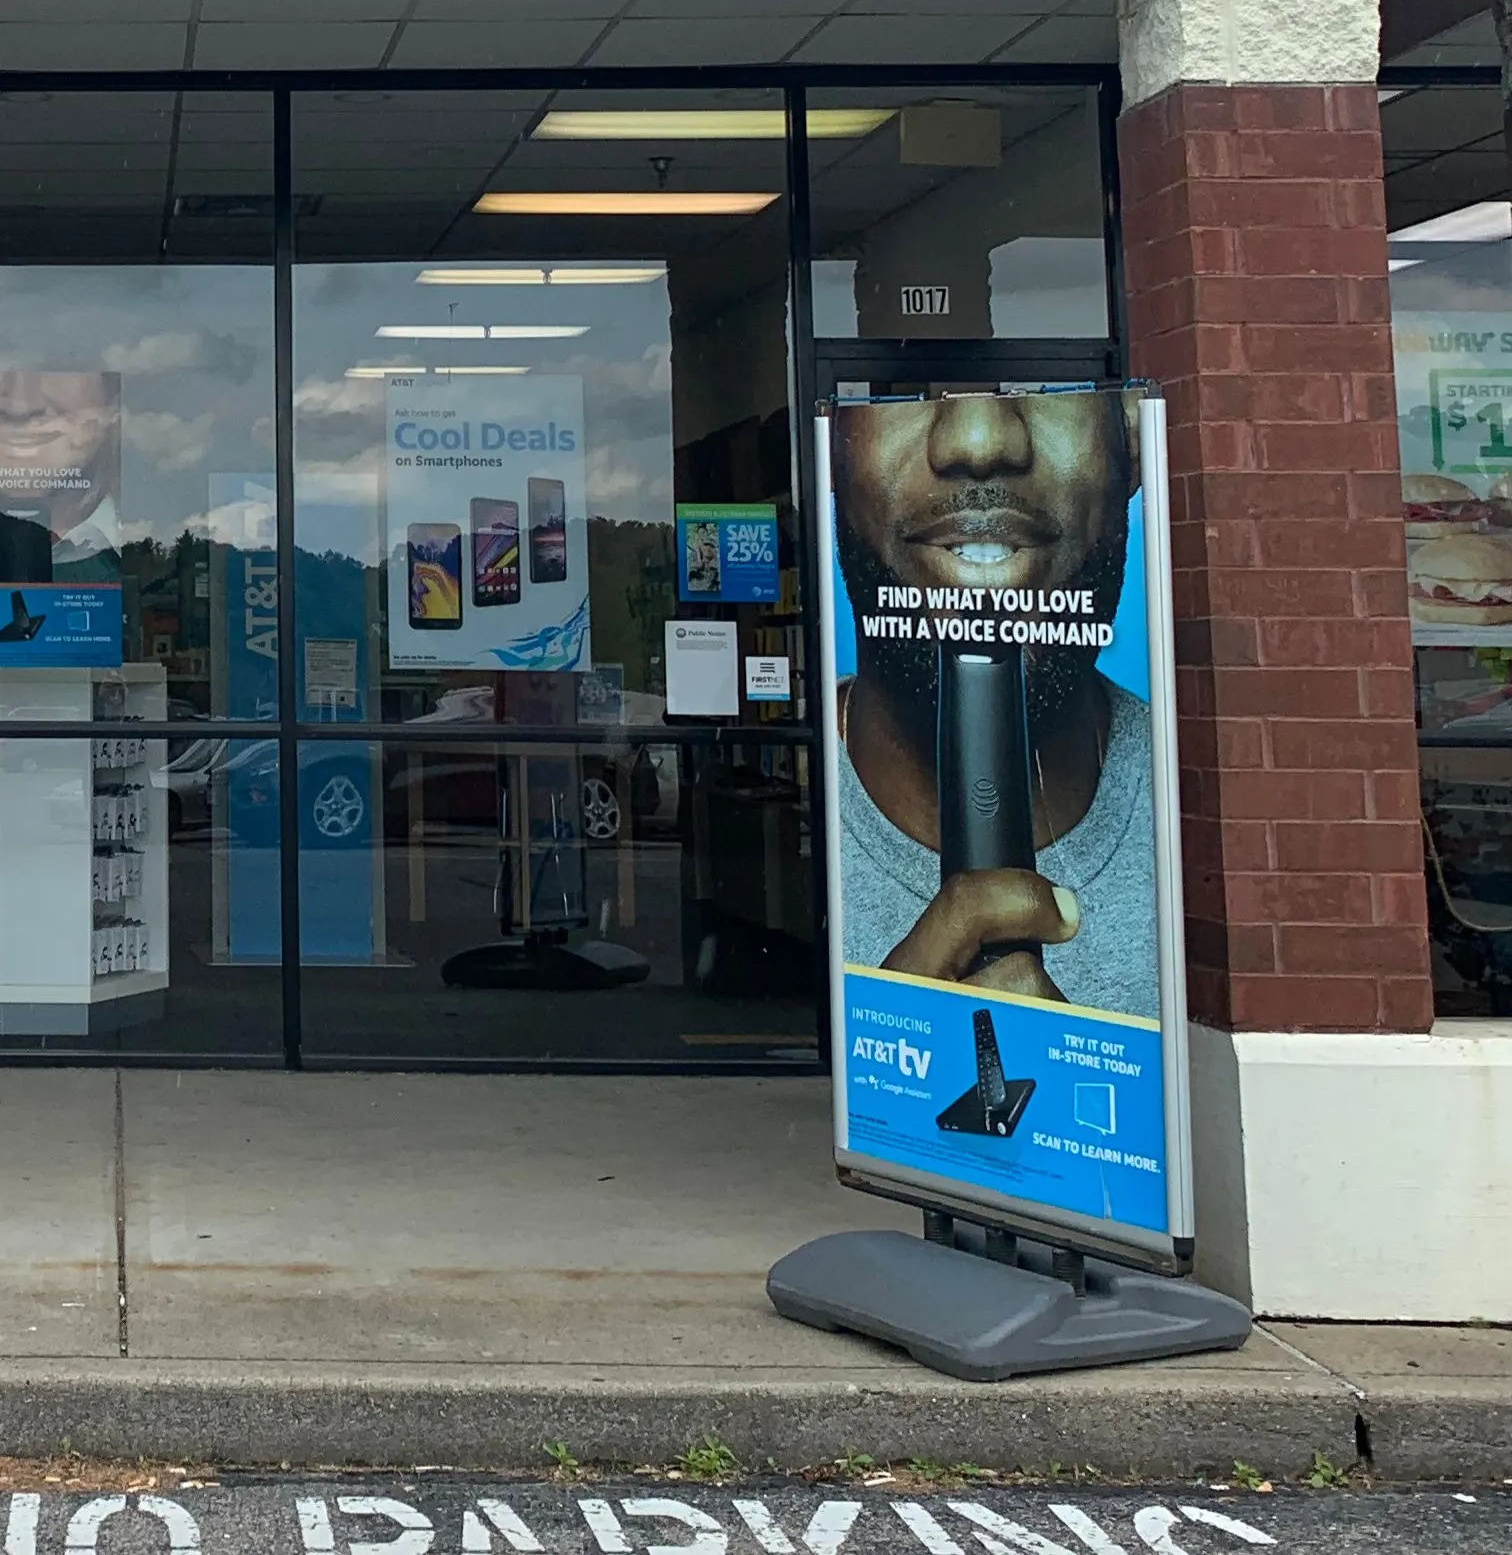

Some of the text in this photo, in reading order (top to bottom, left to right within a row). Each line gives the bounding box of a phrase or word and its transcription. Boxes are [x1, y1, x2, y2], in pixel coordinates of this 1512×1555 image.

[901, 287, 948, 313] 1017
[390, 378, 414, 387] AT&T
[394, 421, 575, 452] Cool Deals
[28, 468, 51, 477] YOU
[53, 468, 81, 477] LOVE
[395, 455, 503, 469] on Smartphones
[34, 480, 91, 489] COMMAND
[726, 524, 771, 542] SAVE
[726, 542, 774, 563] 25%
[244, 557, 279, 660] AT&T
[877, 586, 1095, 614] FIND WHAT YOU LOVE
[862, 615, 1114, 647] WITH A VOICE COMMAND
[852, 1006, 931, 1035] INTRODUCING
[853, 1036, 931, 1079] AT&T tv
[1063, 1034, 1125, 1057] TRY IT OUT
[1048, 1046, 1142, 1078] IN-STORE TODAY
[1032, 1131, 1162, 1174] SCAN TO LEARN MORE.
